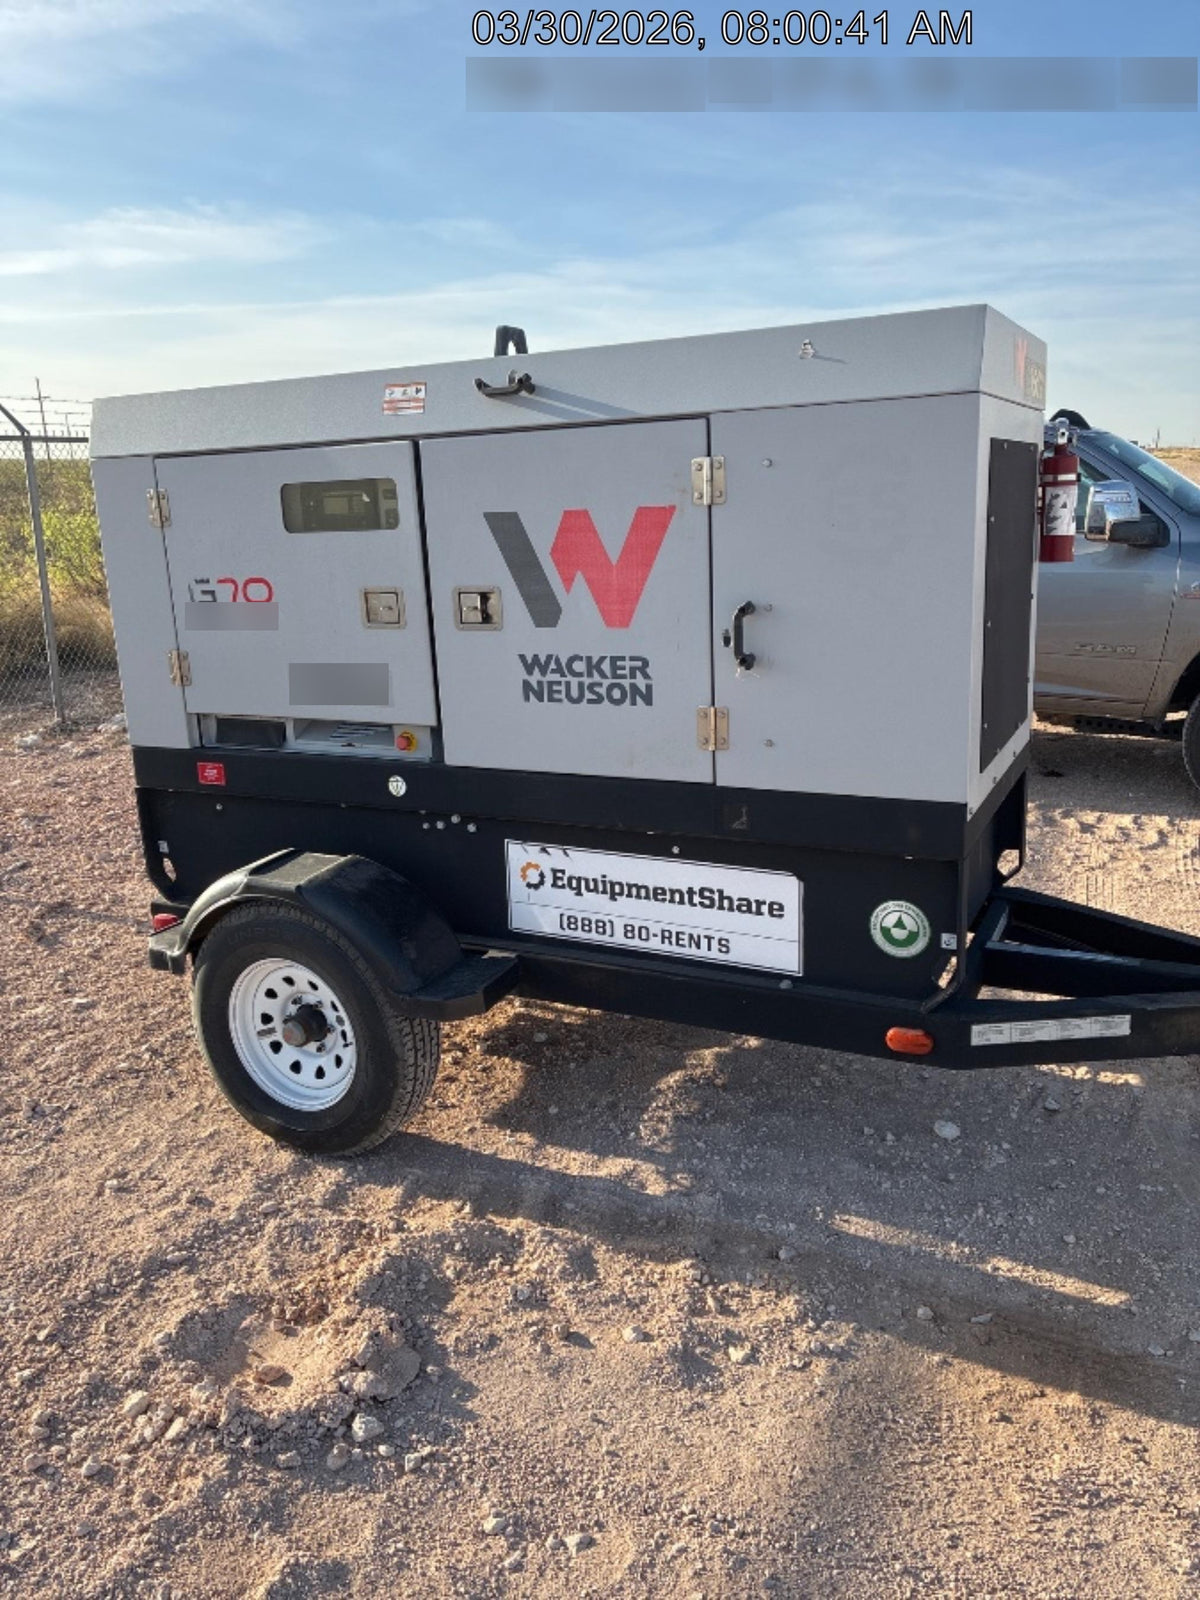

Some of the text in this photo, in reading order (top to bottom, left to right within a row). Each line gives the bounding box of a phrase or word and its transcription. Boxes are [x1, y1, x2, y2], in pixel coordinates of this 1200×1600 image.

[518, 654, 652, 680] WACKER
[522, 679, 653, 706] NEUSON
[550, 867, 785, 919] EquipmentShare
[559, 913, 731, 954] (888) 80-RENTS
